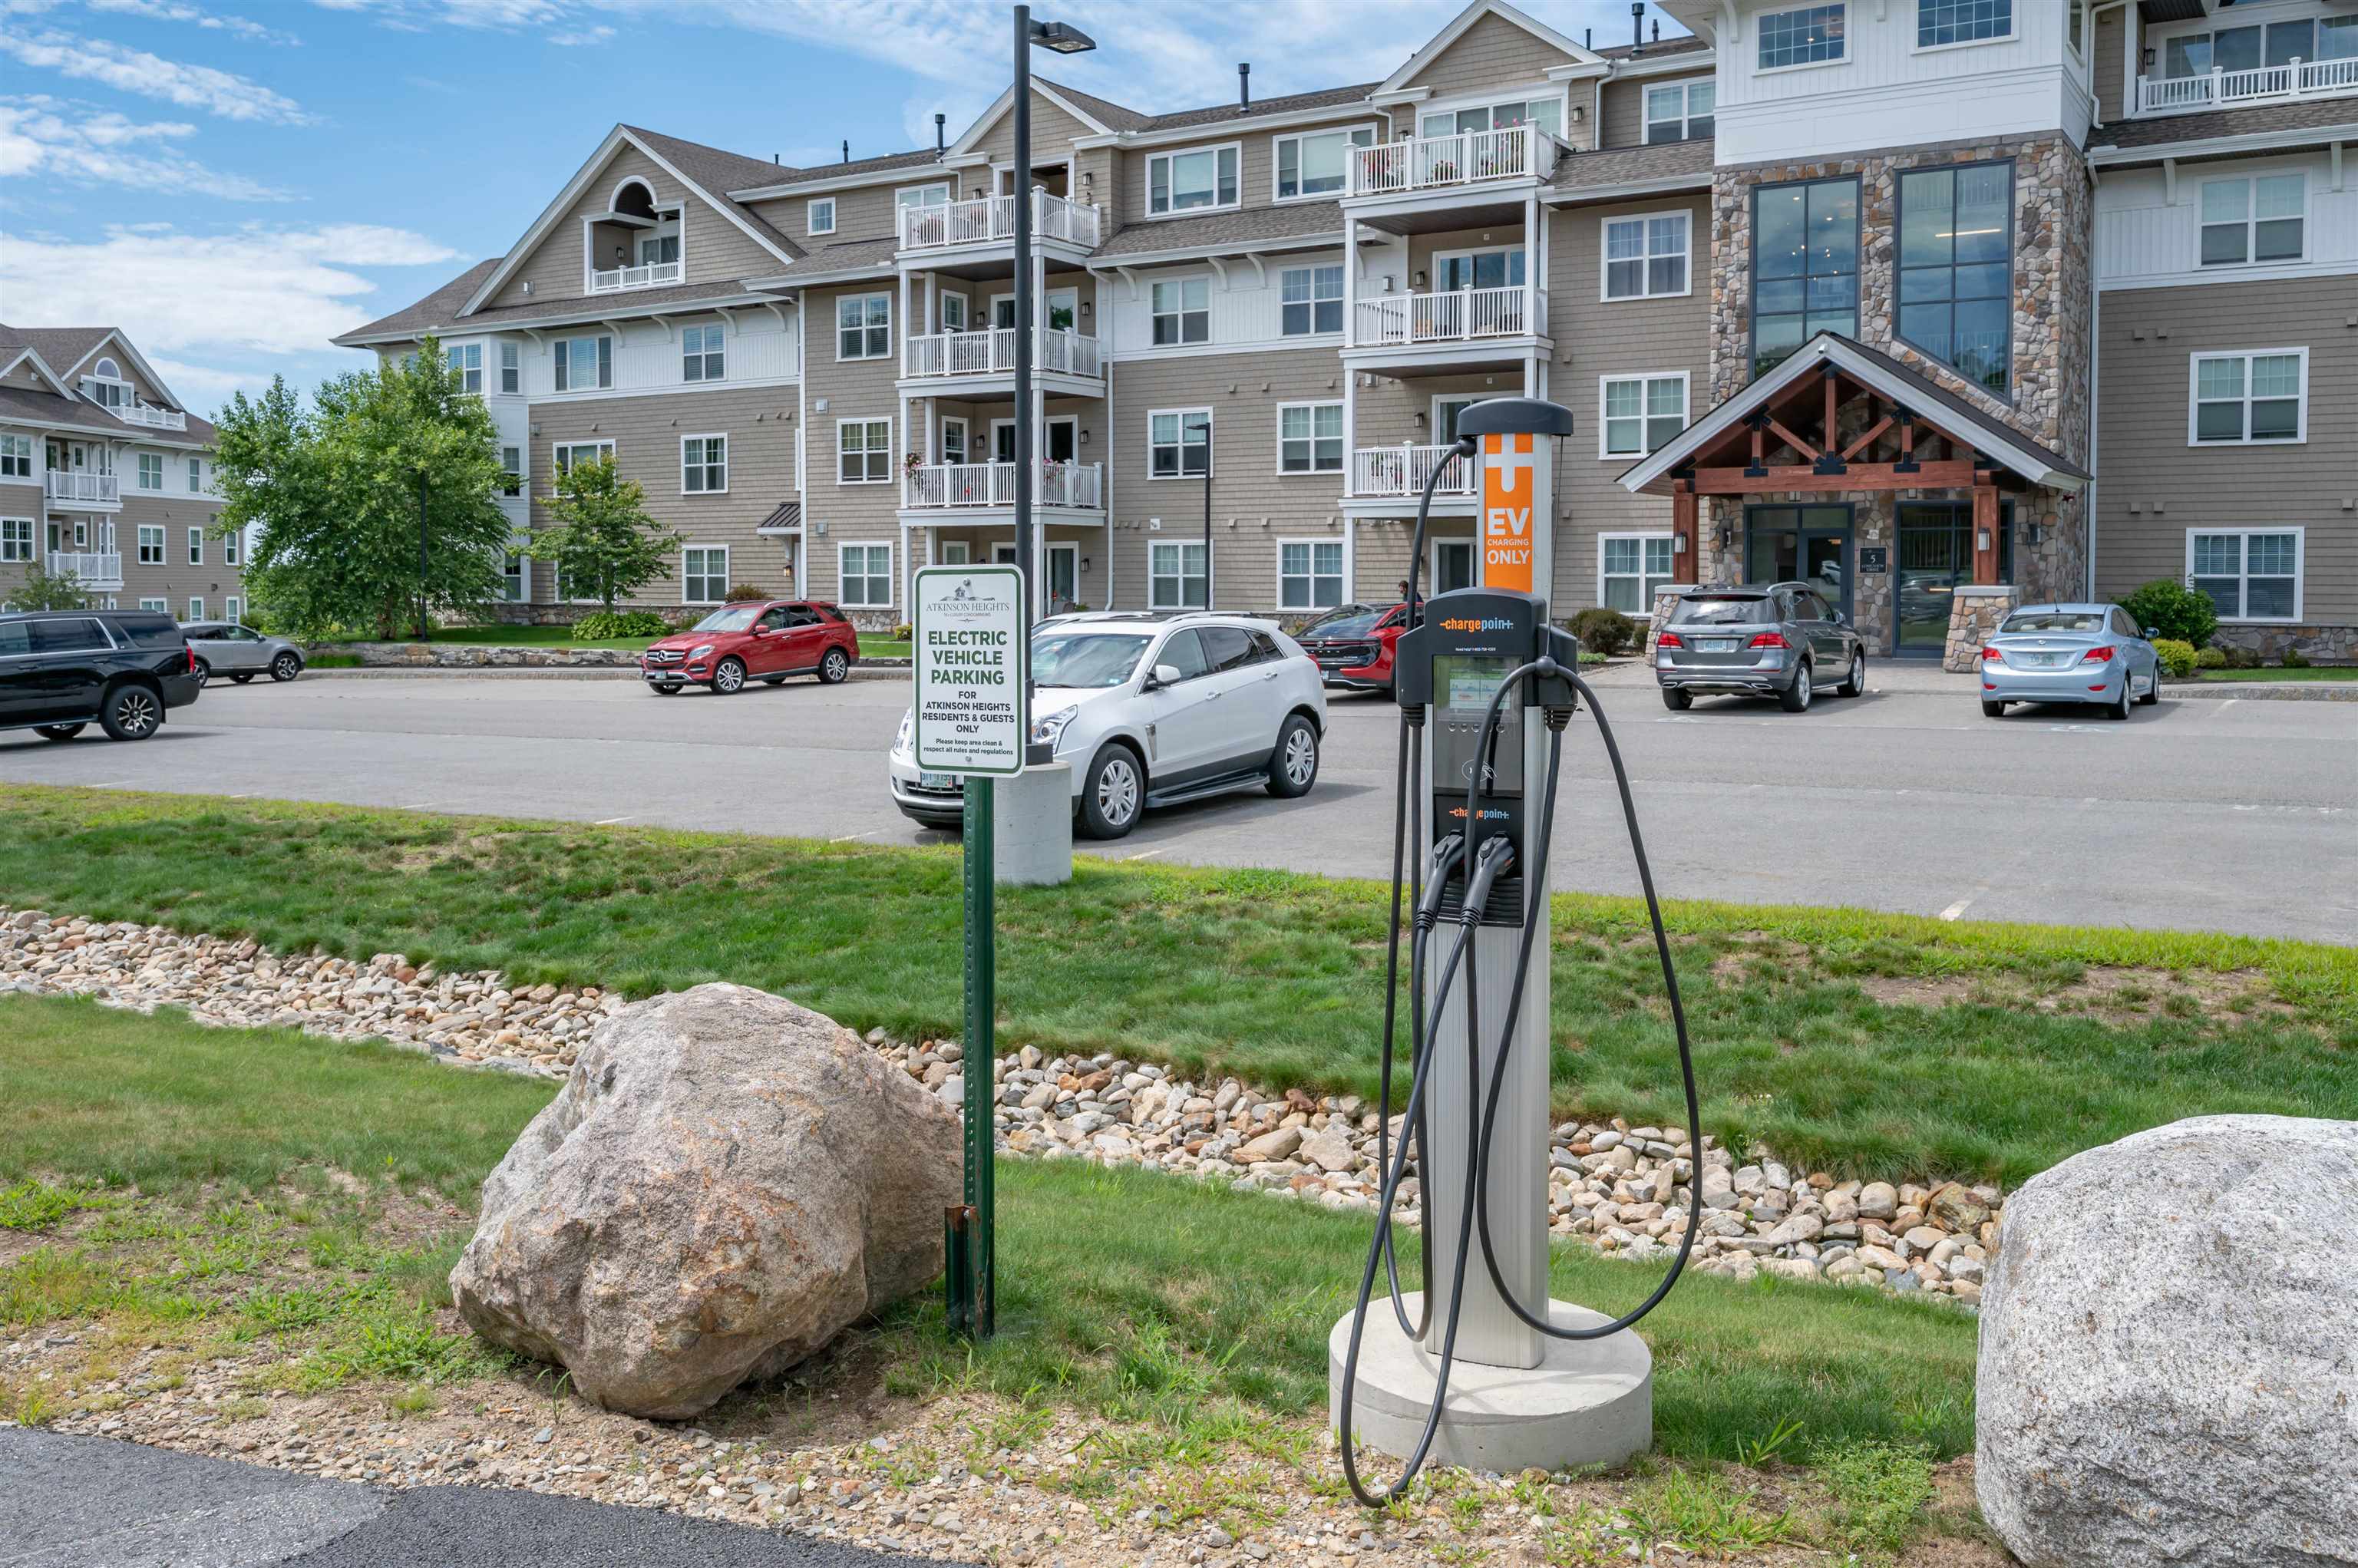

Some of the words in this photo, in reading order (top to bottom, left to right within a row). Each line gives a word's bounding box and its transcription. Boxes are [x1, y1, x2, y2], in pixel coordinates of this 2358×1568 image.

[1488, 507, 1530, 536] EV
[1487, 550, 1530, 565] ONLY
[1870, 554, 1876, 563] 5
[926, 602, 969, 612] ATKINSON
[972, 602, 1009, 612] HEIGHTS
[1440, 617, 1514, 632] chargepoint
[928, 630, 1007, 645] ELECTRIC
[933, 650, 1002, 665] VEHICLE
[931, 669, 1004, 685] PARKING
[958, 691, 976, 699] FOR
[926, 701, 970, 711] ATKINSON
[973, 702, 1011, 711] HEIGHTS
[922, 712, 969, 721] RESIDENTS
[956, 725, 979, 733] ONLY
[1449, 807, 1509, 820] chaepoint
